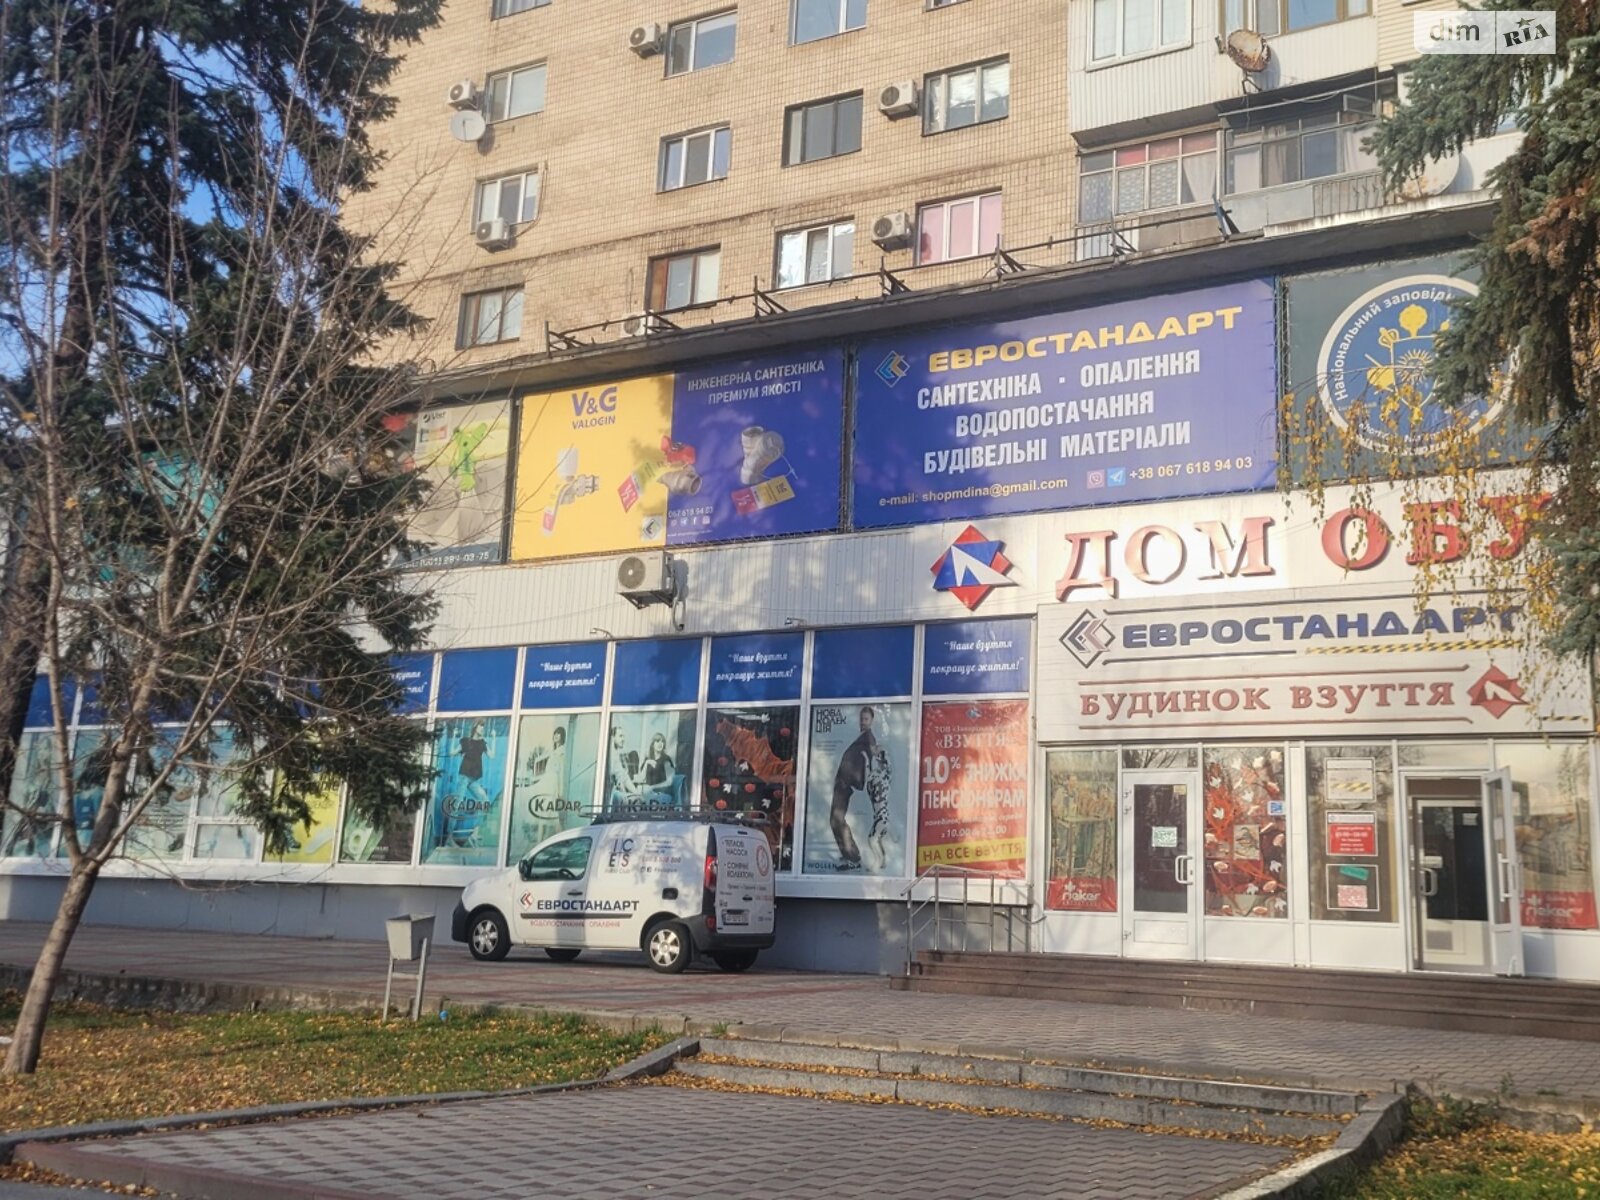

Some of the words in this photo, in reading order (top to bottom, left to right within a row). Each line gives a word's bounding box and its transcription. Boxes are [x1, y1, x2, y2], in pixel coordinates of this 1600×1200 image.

[929, 306, 1242, 373] ЕВРОСТАНДАРТ
[1331, 301, 1382, 401] Національний
[688, 368, 752, 392] ІНЖЕНЕРНА
[755, 359, 825, 383] САНТЕХНІКА
[917, 373, 1041, 410] САНТЕХНІКА
[1080, 350, 1200, 388] ОПАЛЕННЯ
[572, 386, 618, 417] V&G
[708, 386, 758, 405] ПРЕМІУМ
[761, 380, 802, 397] ЯКОСТІ
[572, 415, 616, 430] VALOGIN
[955, 391, 1155, 438] ВОДОПОСТАЧАННЯ
[923, 438, 1047, 475] БУДІВЕЛЬНІ
[1060, 421, 1190, 459] МАТЕРІАЛИ
[1129, 464, 1154, 480] +38
[1158, 464, 1182, 478] 067
[1186, 461, 1211, 475] 618
[1214, 458, 1231, 472] 94
[1235, 456, 1252, 470] 03
[879, 492, 919, 507] e-mail:
[922, 477, 1068, 502] shopmdina@gmail.com
[1055, 515, 1278, 600] ДОМ
[1123, 605, 1524, 649] ЕВРОСТАНДАРТ
[1079, 687, 1270, 721] БУДИНОК
[1290, 680, 1455, 712] ВЗУТТЯ
[923, 755, 961, 784] 10%
[922, 849, 942, 861] НА
[946, 847, 969, 860] ВСЕ
[537, 900, 640, 911] ЕВРОСТАНДАРТ
